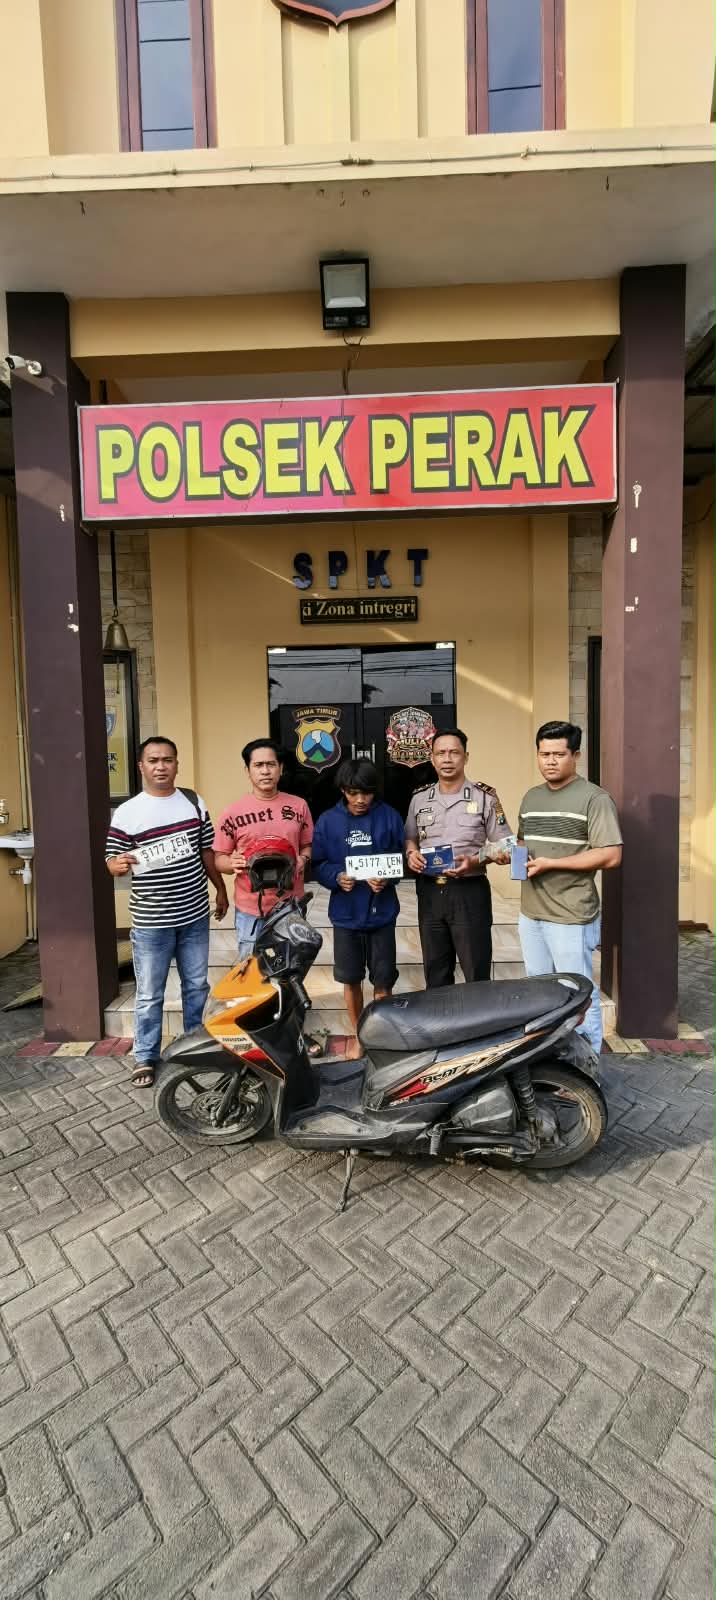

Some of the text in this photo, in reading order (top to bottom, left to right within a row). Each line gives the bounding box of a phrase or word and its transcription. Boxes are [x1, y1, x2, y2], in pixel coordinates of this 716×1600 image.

[97, 406, 596, 503] POLSEK PERAK
[293, 549, 429, 590] SPKT
[317, 601, 355, 616] Zona
[296, 707, 338, 718] JAWA TIMUR
[220, 807, 274, 840] Planet
[141, 843, 165, 860] 5177
[348, 859, 353, 868] N
[358, 858, 380, 868] 5177
